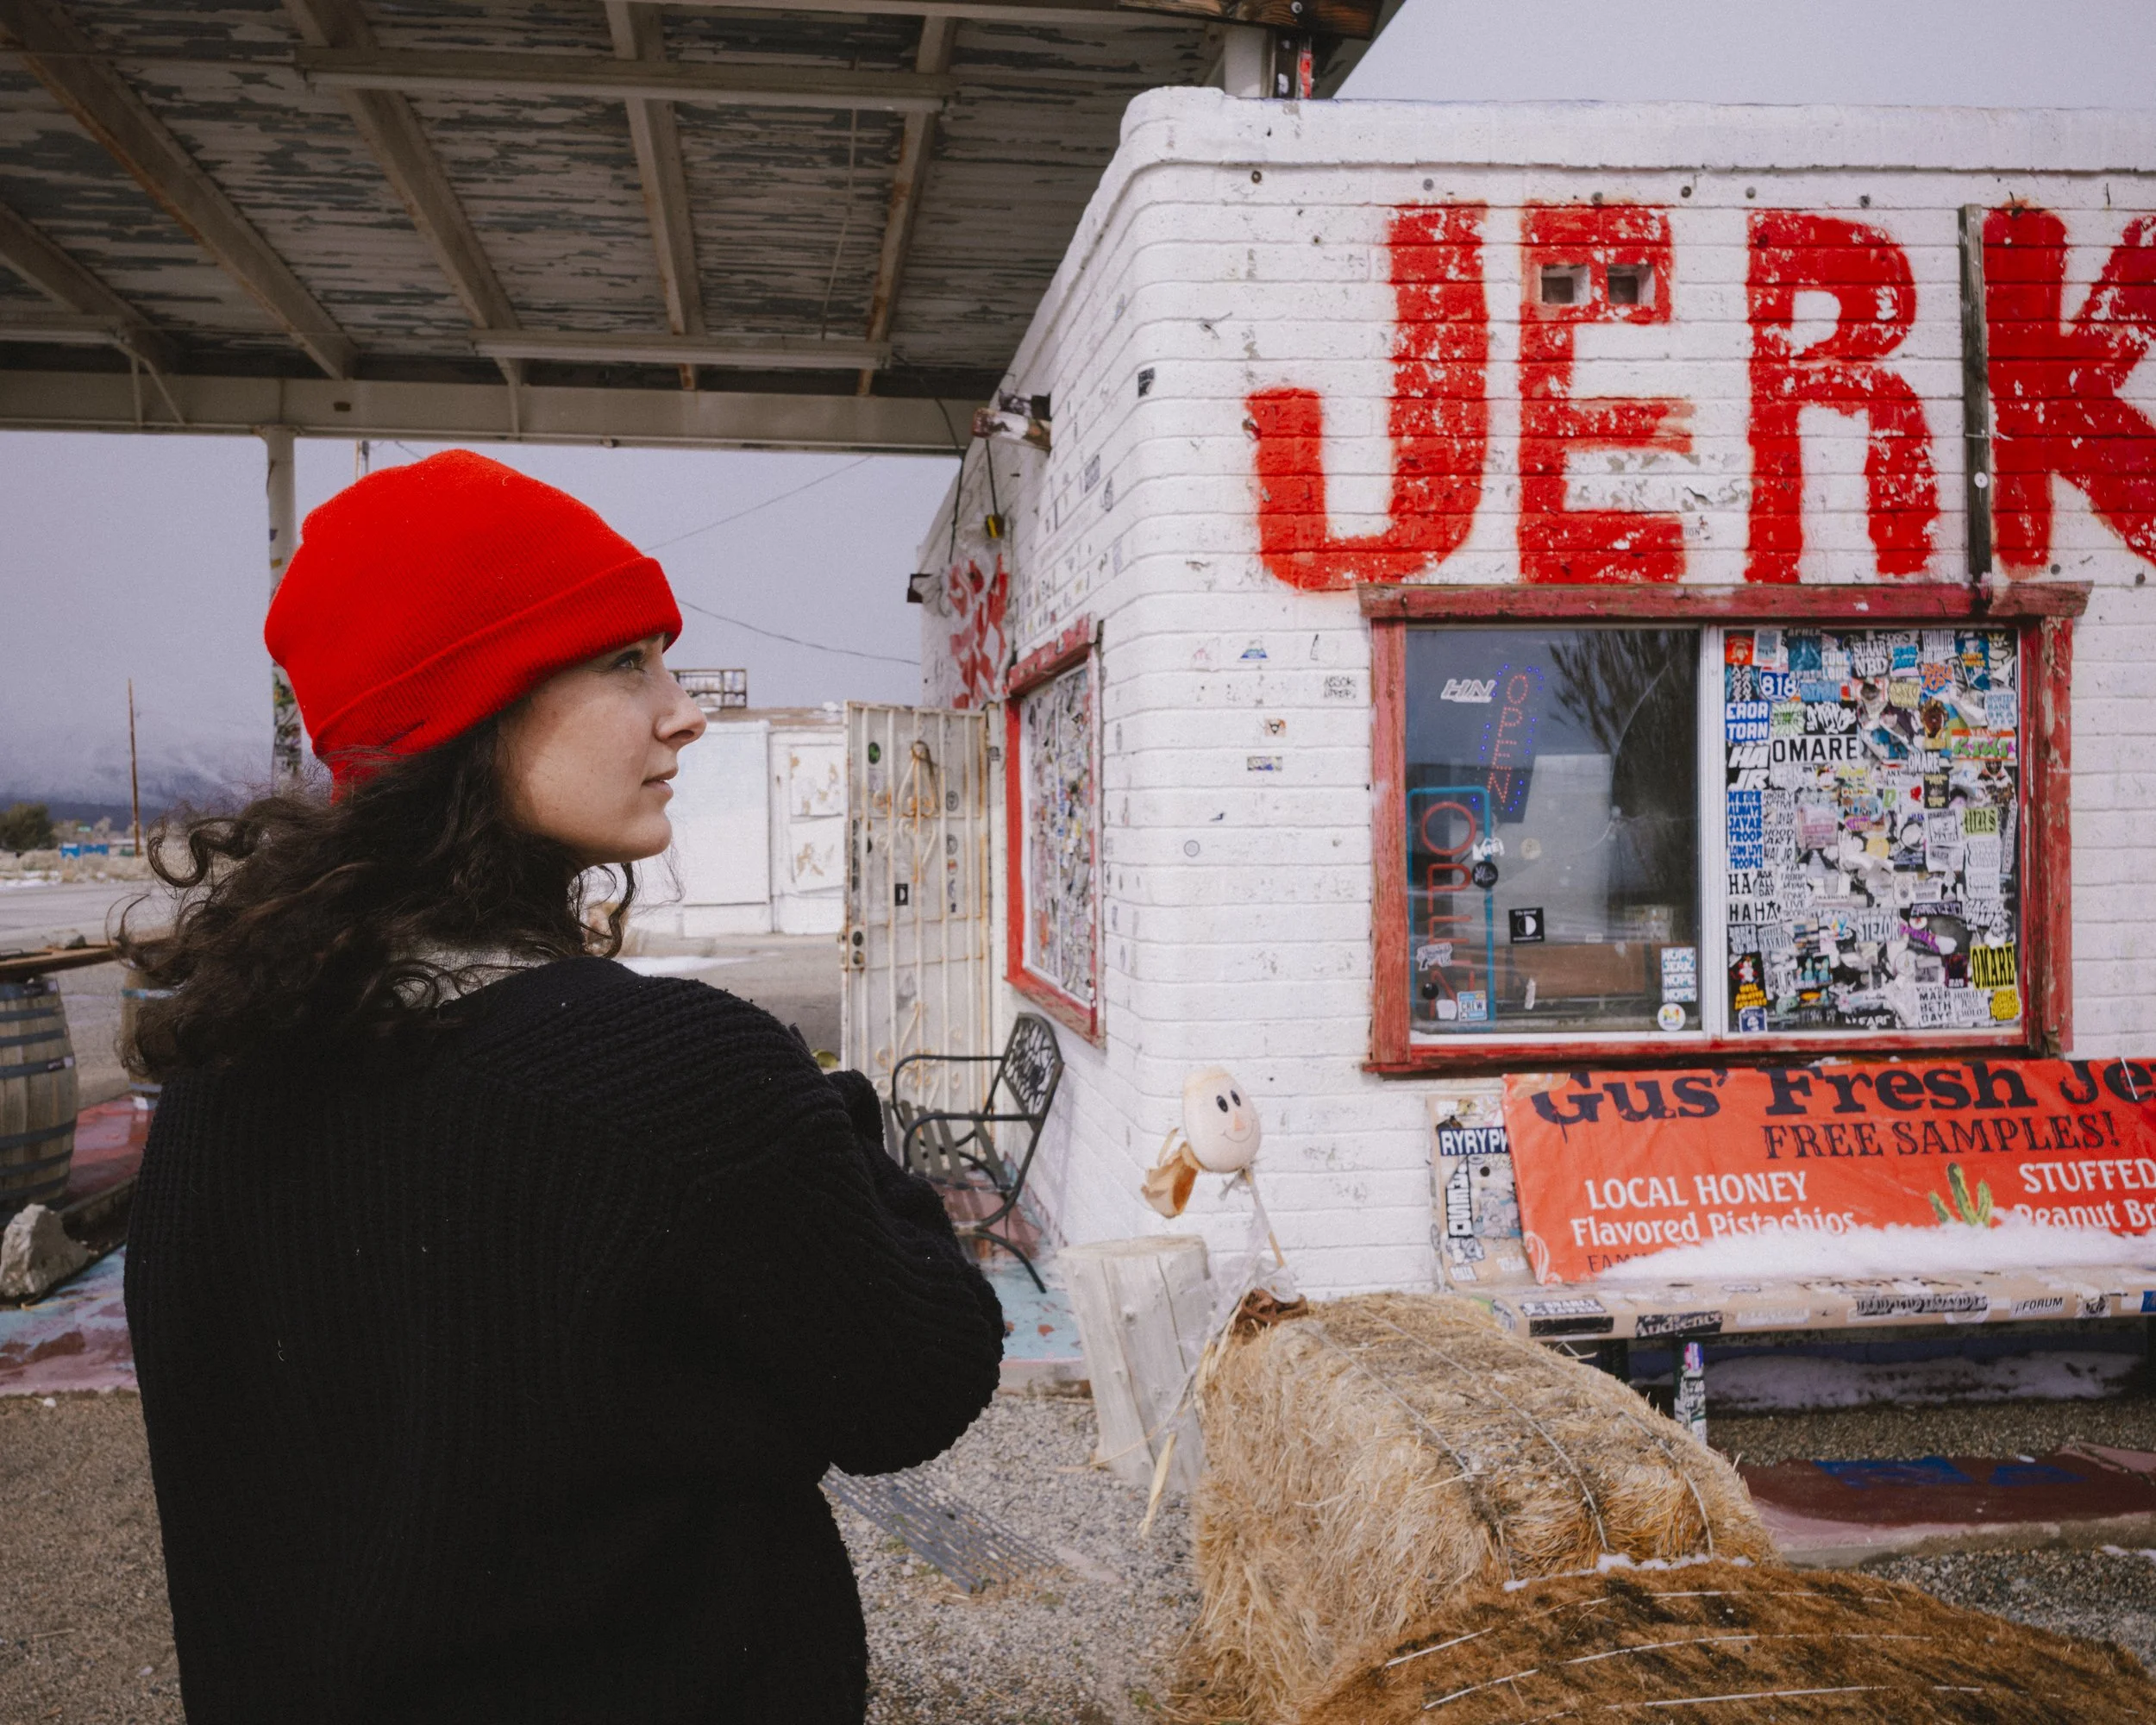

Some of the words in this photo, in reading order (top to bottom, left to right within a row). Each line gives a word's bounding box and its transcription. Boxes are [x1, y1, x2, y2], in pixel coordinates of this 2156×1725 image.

[1244, 198, 2156, 593] JERK
[1762, 675, 1796, 696] 818
[1487, 674, 1528, 803] OPEN
[1772, 737, 1858, 762] OMARE
[1952, 737, 2009, 757] KIWI
[1727, 746, 1770, 768] HA
[1727, 769, 1769, 790] JR
[1729, 831, 1763, 843] TROOP
[1728, 873, 1752, 895] HA
[1422, 800, 1477, 1019] OPEN
[1728, 903, 1752, 922] HA
[1757, 1062, 2038, 1116] Fresh
[2059, 1059, 2156, 1104] Je
[1762, 1122, 1883, 1159] FREE
[1896, 1111, 2122, 1155] SAMPLES!
[2019, 1158, 2156, 1194] STUFFED
[1585, 1176, 1689, 1209] LOCAL
[1695, 1171, 1807, 1205] HONEY
[1570, 1213, 1701, 1247] Flavored
[2022, 1297, 2063, 1312] FORUM
[1638, 1311, 1723, 1336] Audience
